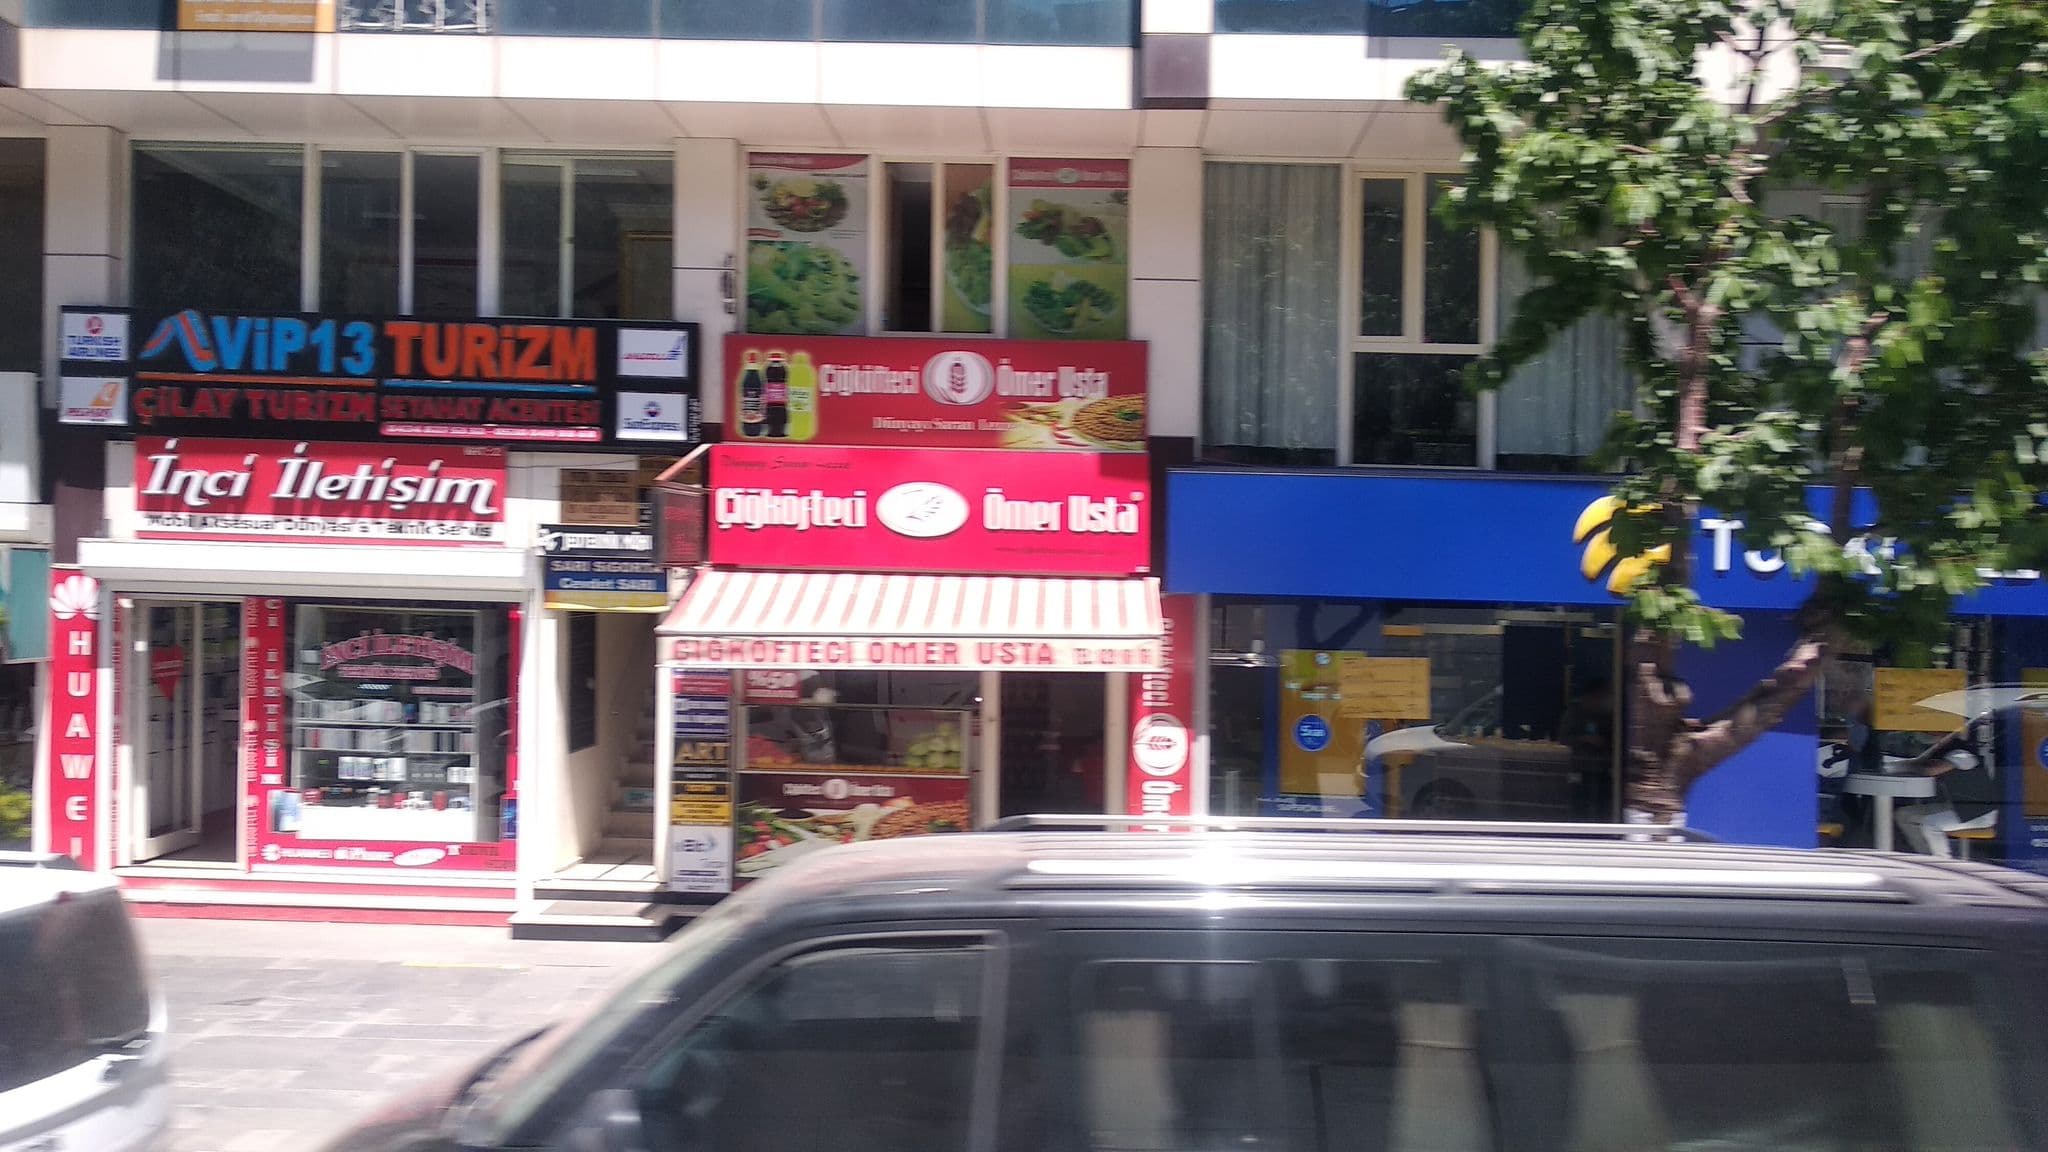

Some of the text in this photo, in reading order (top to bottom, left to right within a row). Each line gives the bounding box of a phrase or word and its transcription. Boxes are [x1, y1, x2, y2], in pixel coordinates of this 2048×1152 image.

[996, 357, 1057, 396] Ömer
[1057, 365, 1109, 398] Usta
[141, 438, 258, 506] İnci
[268, 442, 500, 515] İletişim
[982, 487, 1064, 532] Ömer
[1067, 495, 1140, 534] Usta
[977, 640, 1055, 666] USTA
[60, 629, 95, 859] HUAWEI
